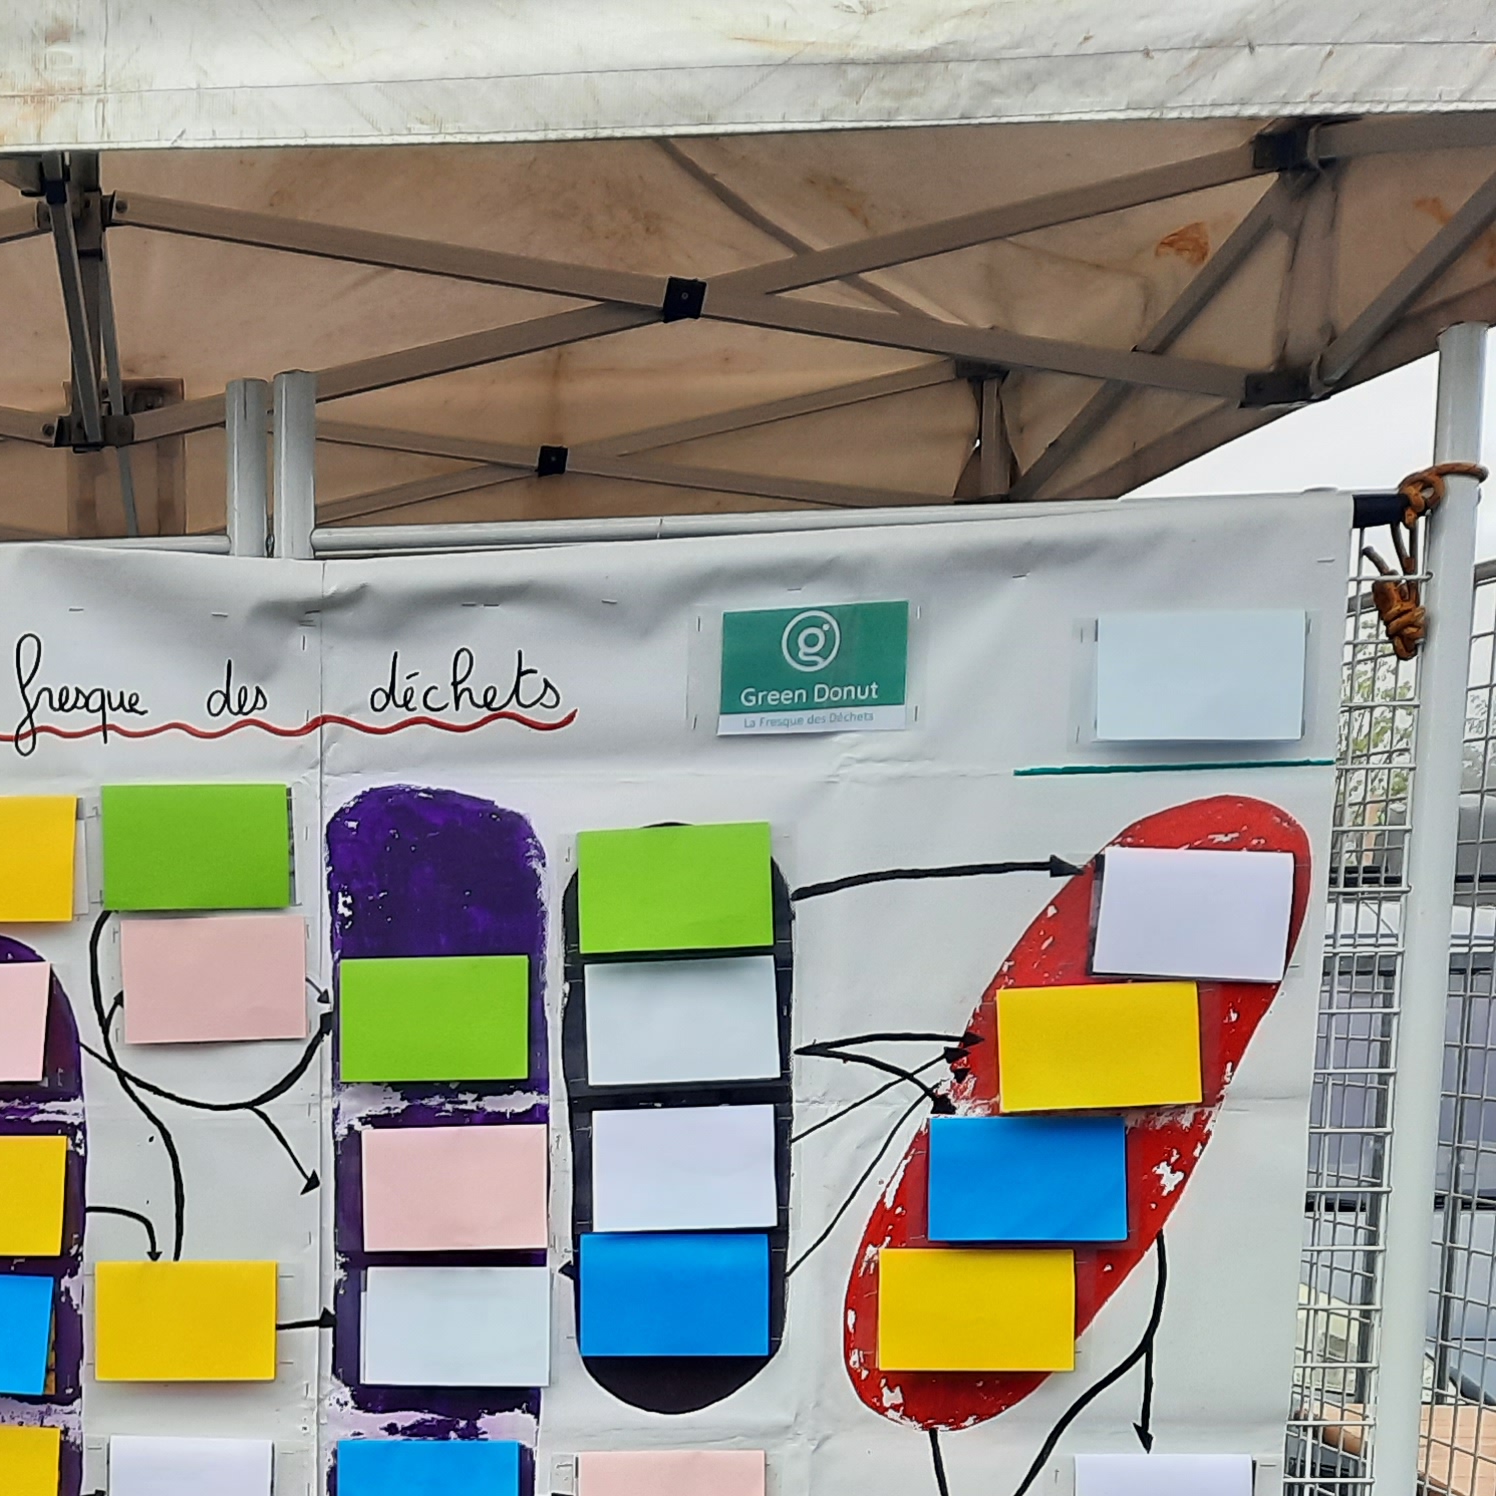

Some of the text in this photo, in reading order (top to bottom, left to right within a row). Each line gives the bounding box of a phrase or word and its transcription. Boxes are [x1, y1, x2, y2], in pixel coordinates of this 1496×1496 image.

[13, 632, 150, 757] fresque
[207, 659, 269, 718] des
[369, 647, 561, 715] déchets
[739, 681, 880, 708] Green Donut
[743, 710, 875, 731] La Fresque des Déchets
